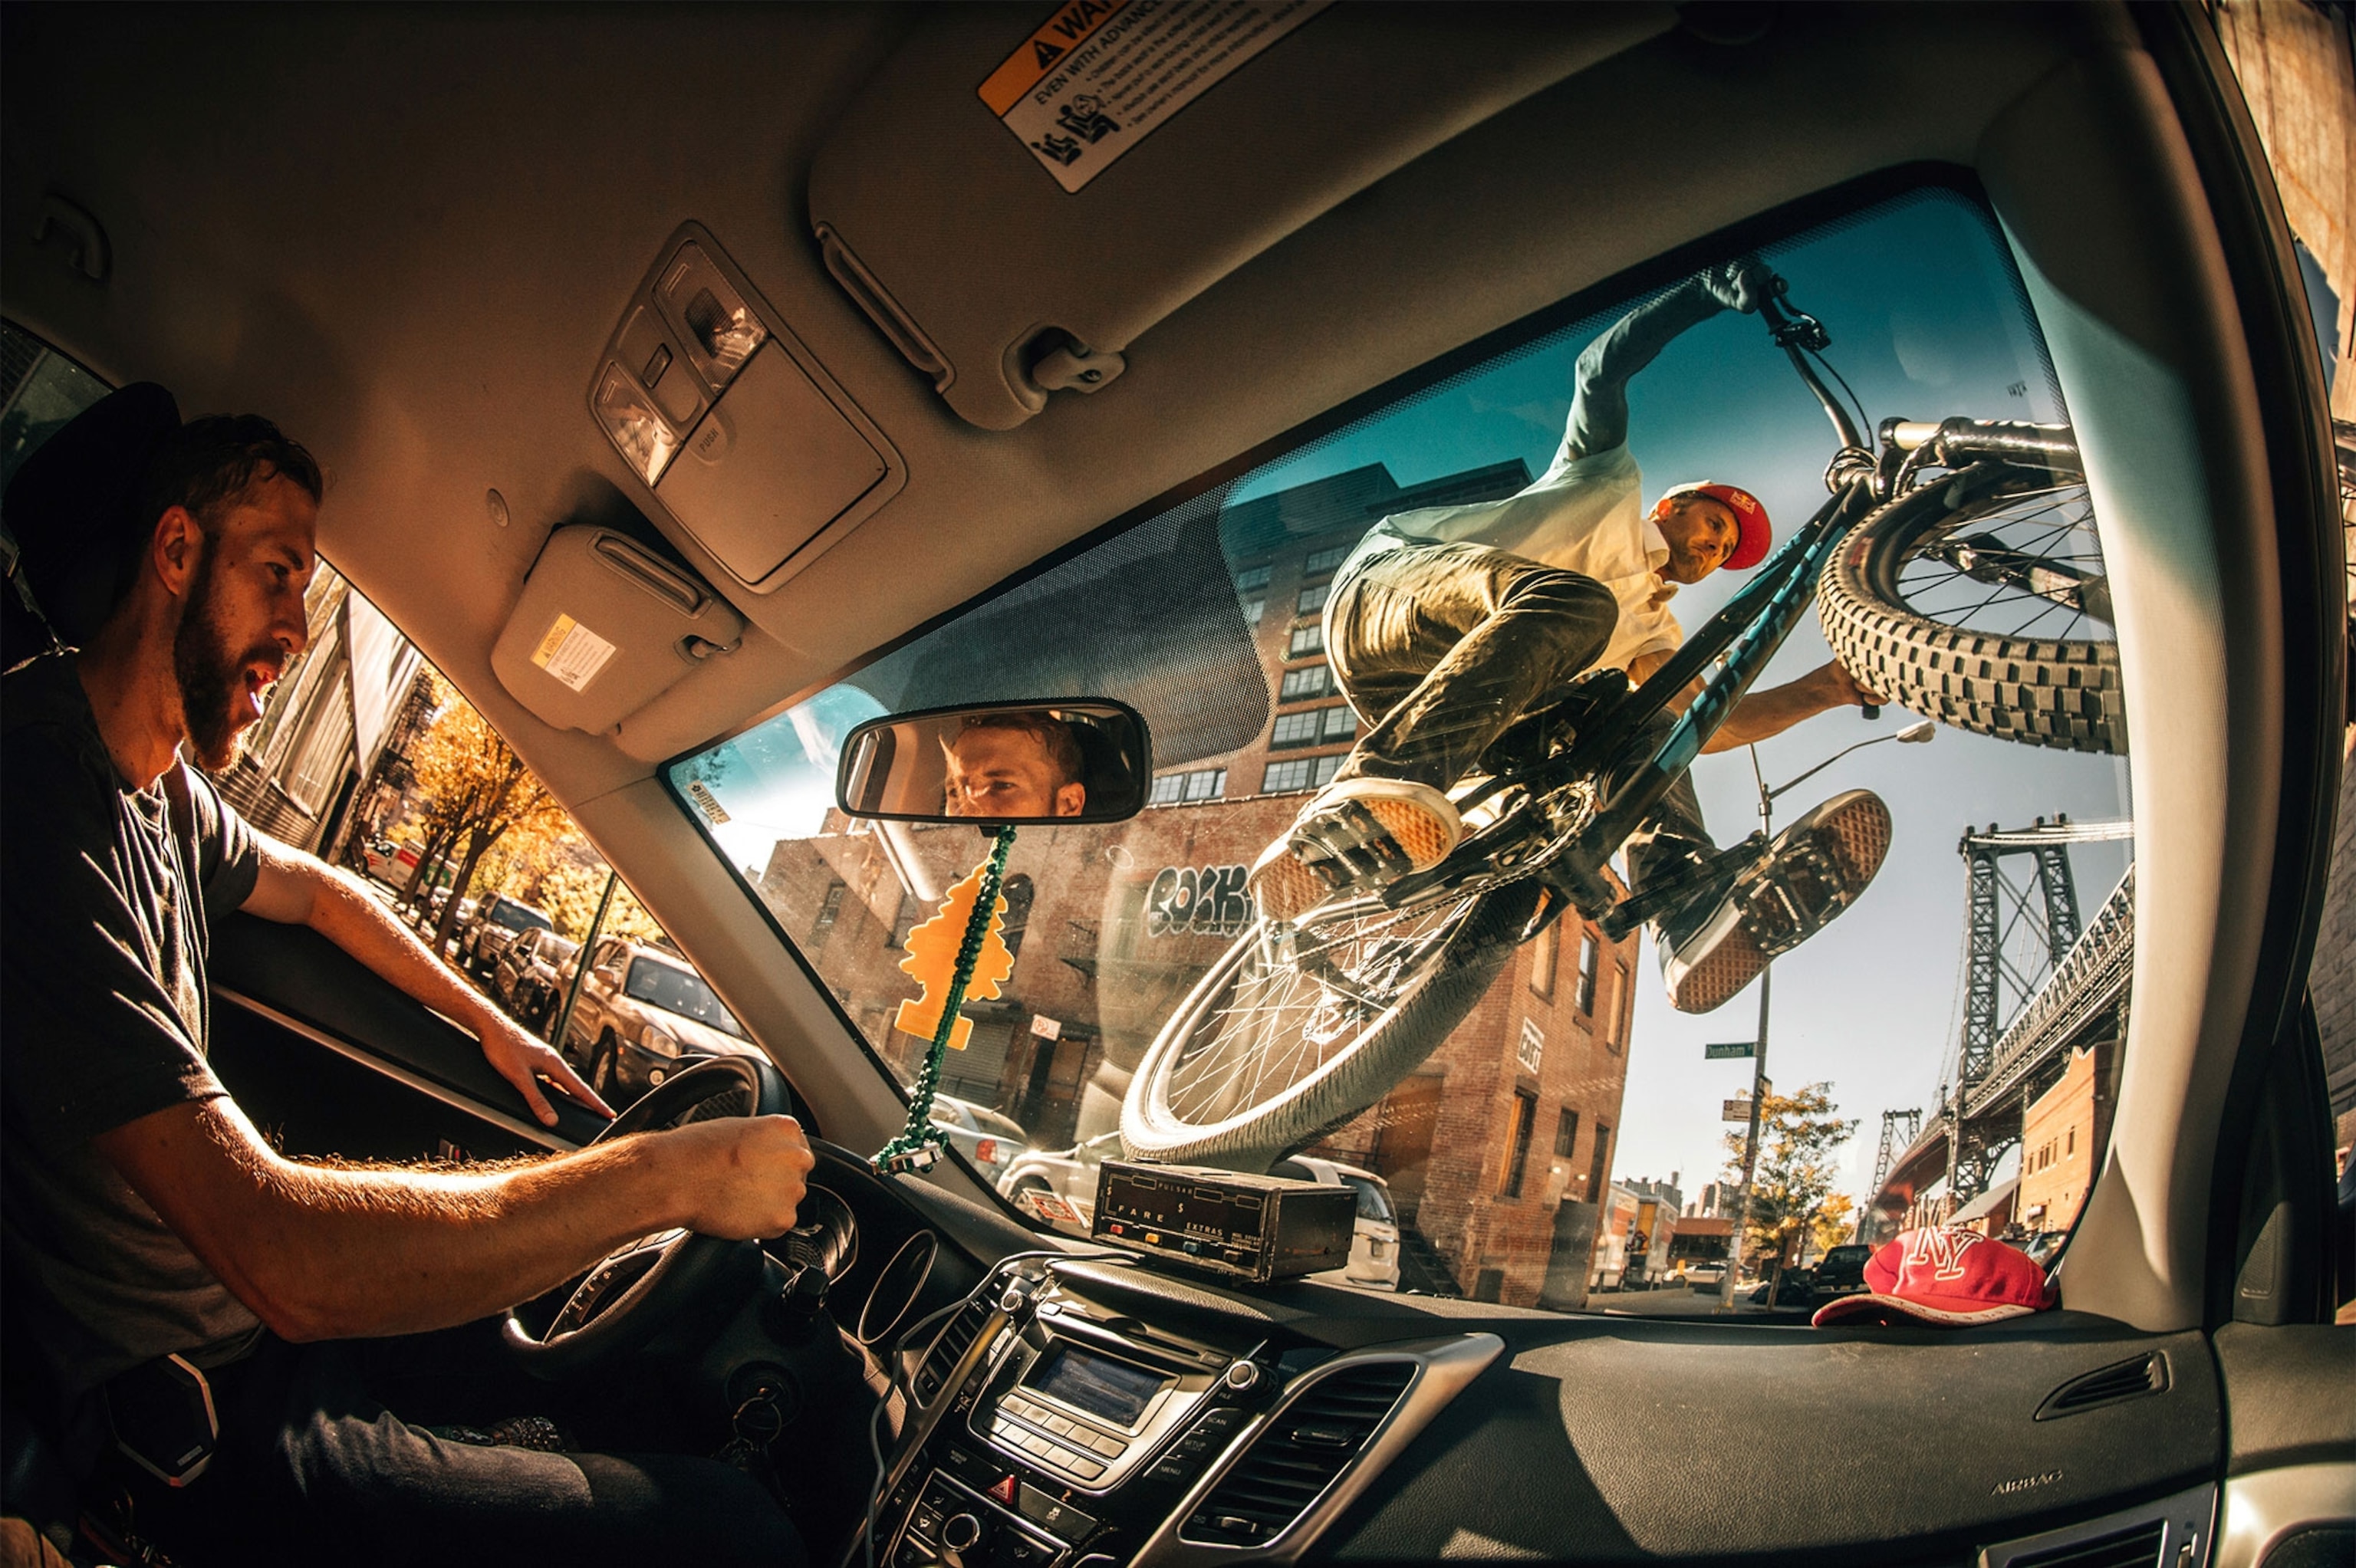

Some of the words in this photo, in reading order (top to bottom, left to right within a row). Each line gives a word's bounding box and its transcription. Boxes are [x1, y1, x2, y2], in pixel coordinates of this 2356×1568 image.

[1034, 75, 1070, 106] EVEN
[1064, 48, 1101, 77] WITH
[699, 427, 719, 452] PUSH
[1706, 1045, 1746, 1057] Dunham
[1159, 1182, 1193, 1195] PULSAR
[1118, 1205, 1164, 1223] FARE
[1186, 1222, 1225, 1237] EXTRAS
[1907, 1225, 1983, 1281] NY
[1278, 1363, 1298, 1373] ENTER
[1207, 1416, 1227, 1426] SCAN
[1184, 1439, 1206, 1448] SETUP
[1160, 1465, 1181, 1476] MENU
[1989, 1469, 2064, 1497] AIRBAG
